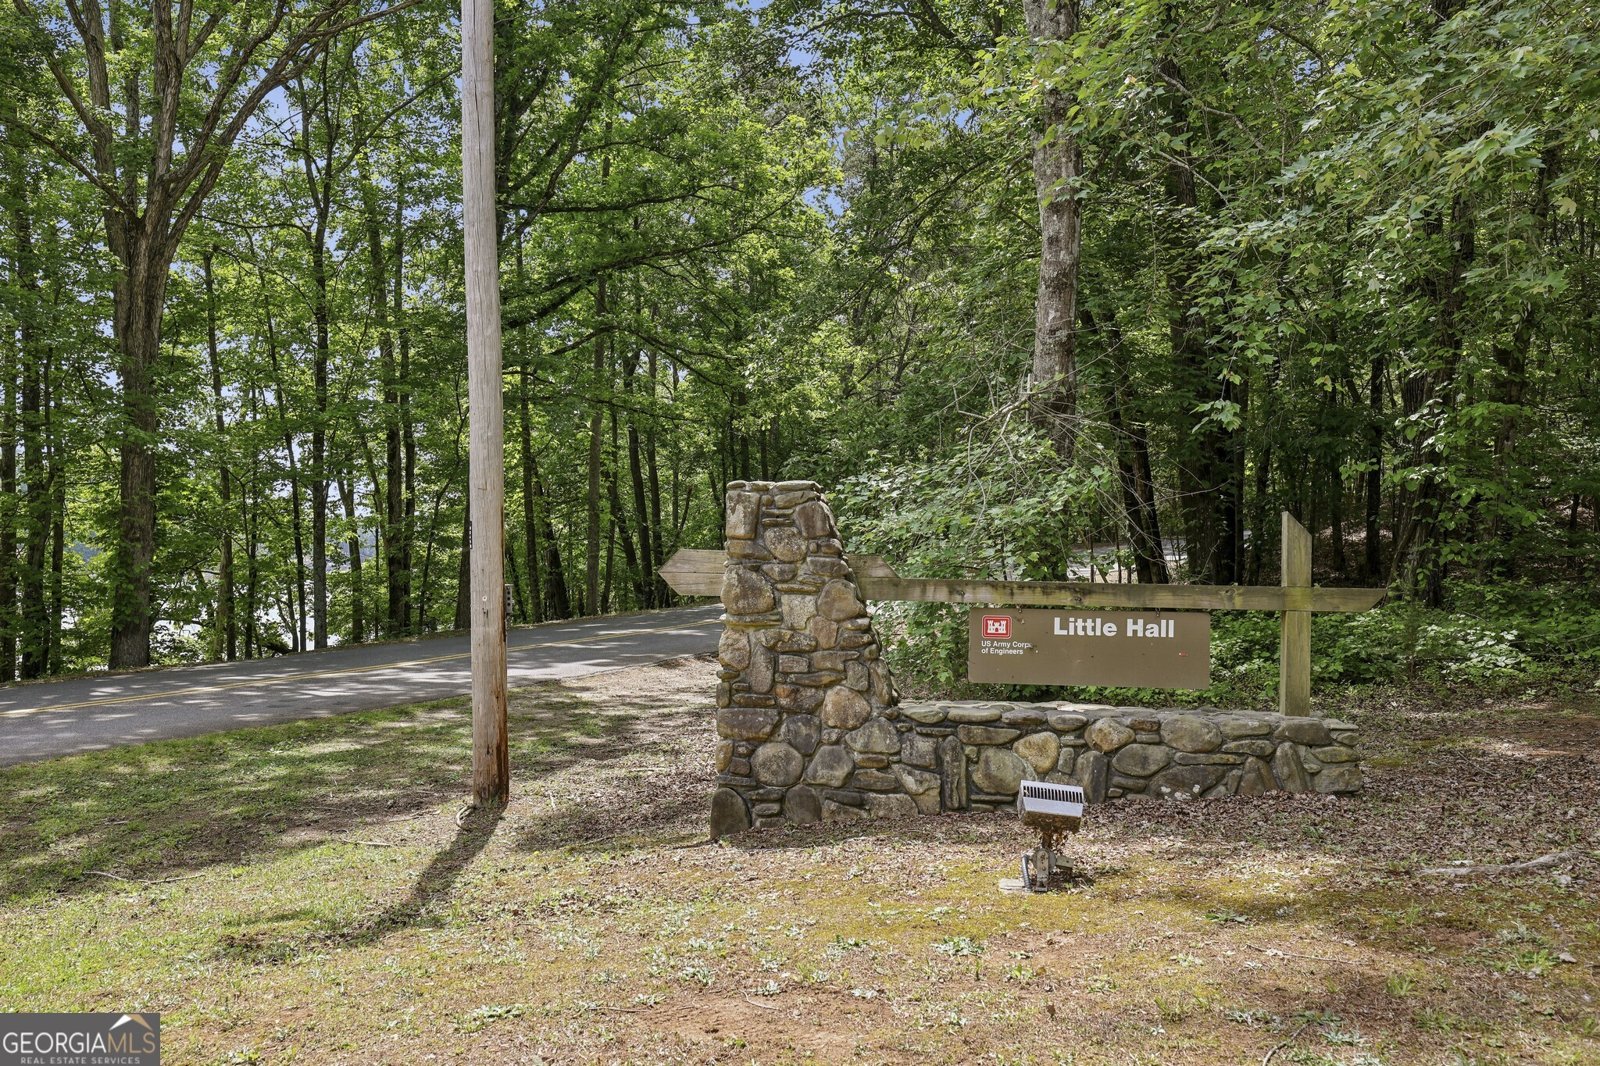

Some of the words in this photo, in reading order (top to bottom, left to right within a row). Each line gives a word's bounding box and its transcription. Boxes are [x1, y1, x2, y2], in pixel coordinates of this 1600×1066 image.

[1053, 617, 1118, 637] Little
[1126, 618, 1175, 638] Hall
[993, 641, 1011, 649] Army
[990, 648, 1024, 656] Engineers
